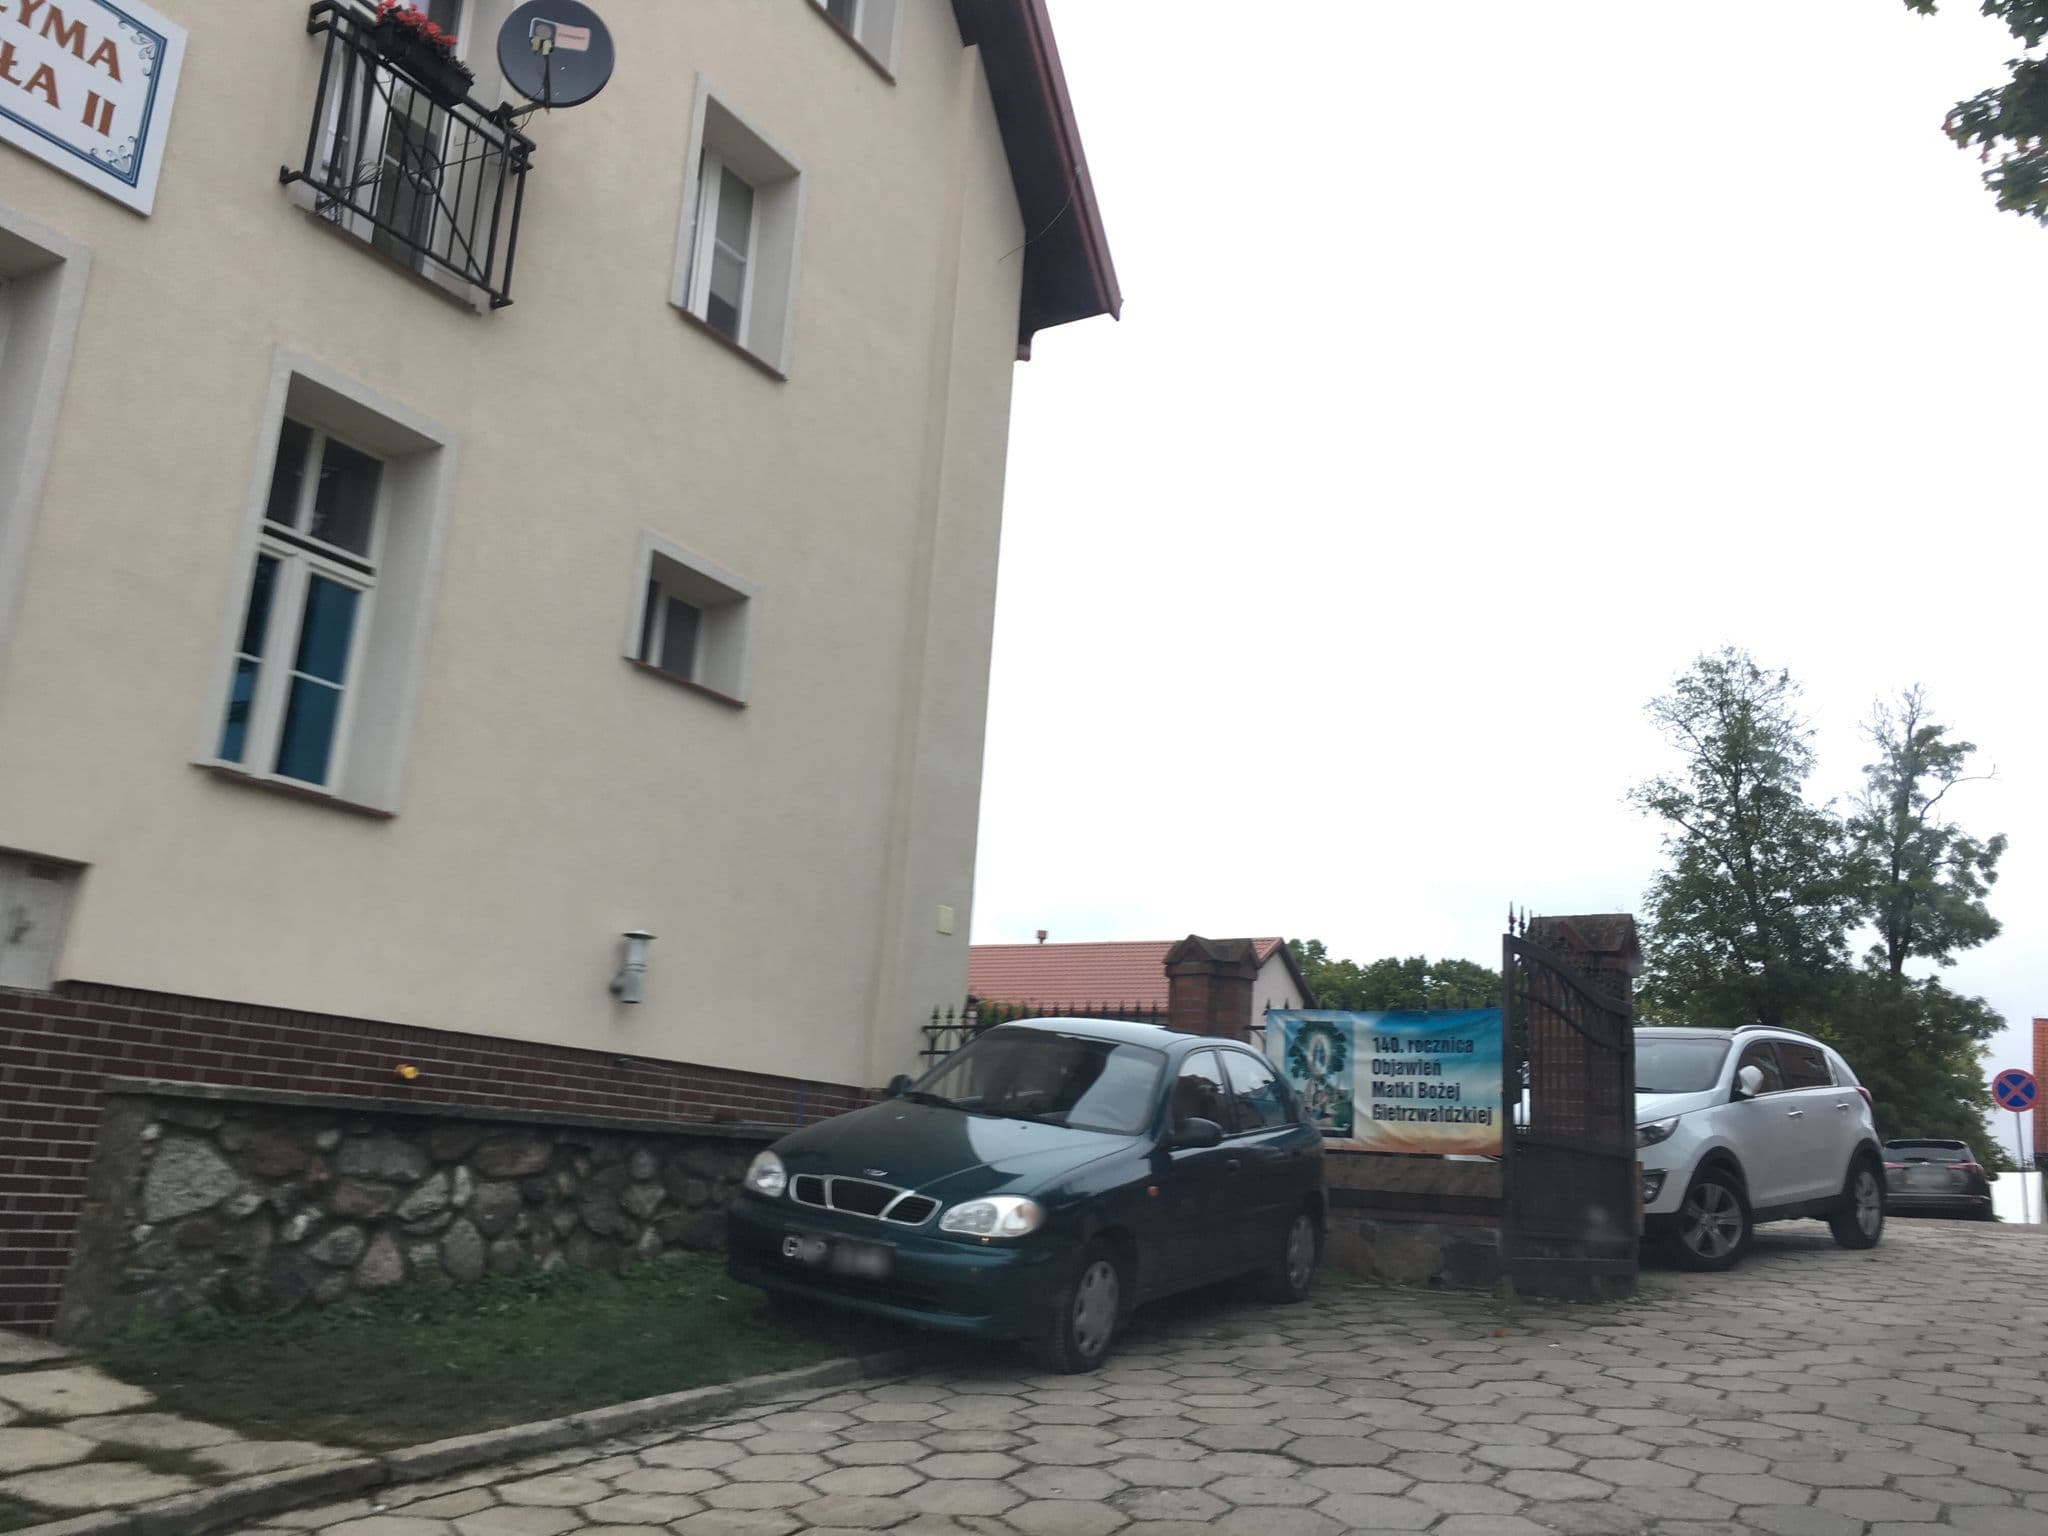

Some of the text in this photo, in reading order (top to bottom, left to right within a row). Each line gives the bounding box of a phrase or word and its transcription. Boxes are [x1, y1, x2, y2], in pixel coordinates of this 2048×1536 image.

[0, 0, 123, 83] YMA
[80, 89, 117, 138] II
[1372, 1037, 1474, 1054] 140. rocznica
[1372, 1058, 1442, 1077] Objawień
[1371, 1080, 1460, 1101] Matki Bożej
